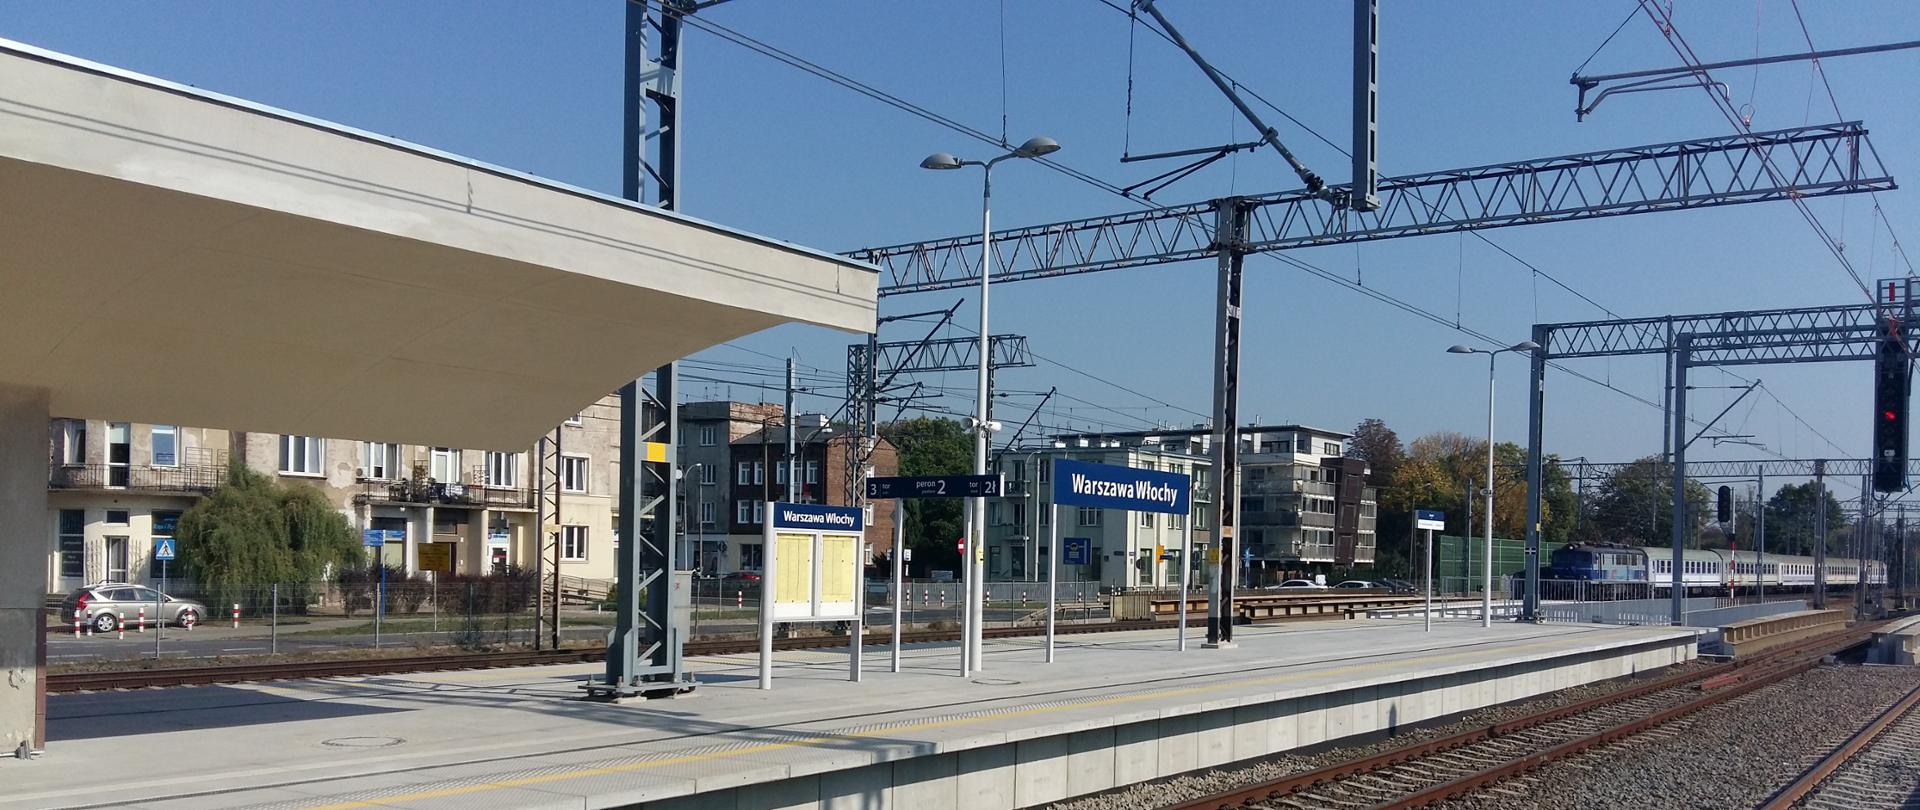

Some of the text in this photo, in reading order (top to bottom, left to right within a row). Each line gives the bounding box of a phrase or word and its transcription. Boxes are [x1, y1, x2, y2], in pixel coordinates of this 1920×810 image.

[870, 483, 877, 496] 3
[916, 480, 936, 489] peron
[937, 479, 946, 495] 2
[1072, 473, 1178, 507] Warszawa Włochy
[783, 510, 855, 527] Warszawa Włochy
